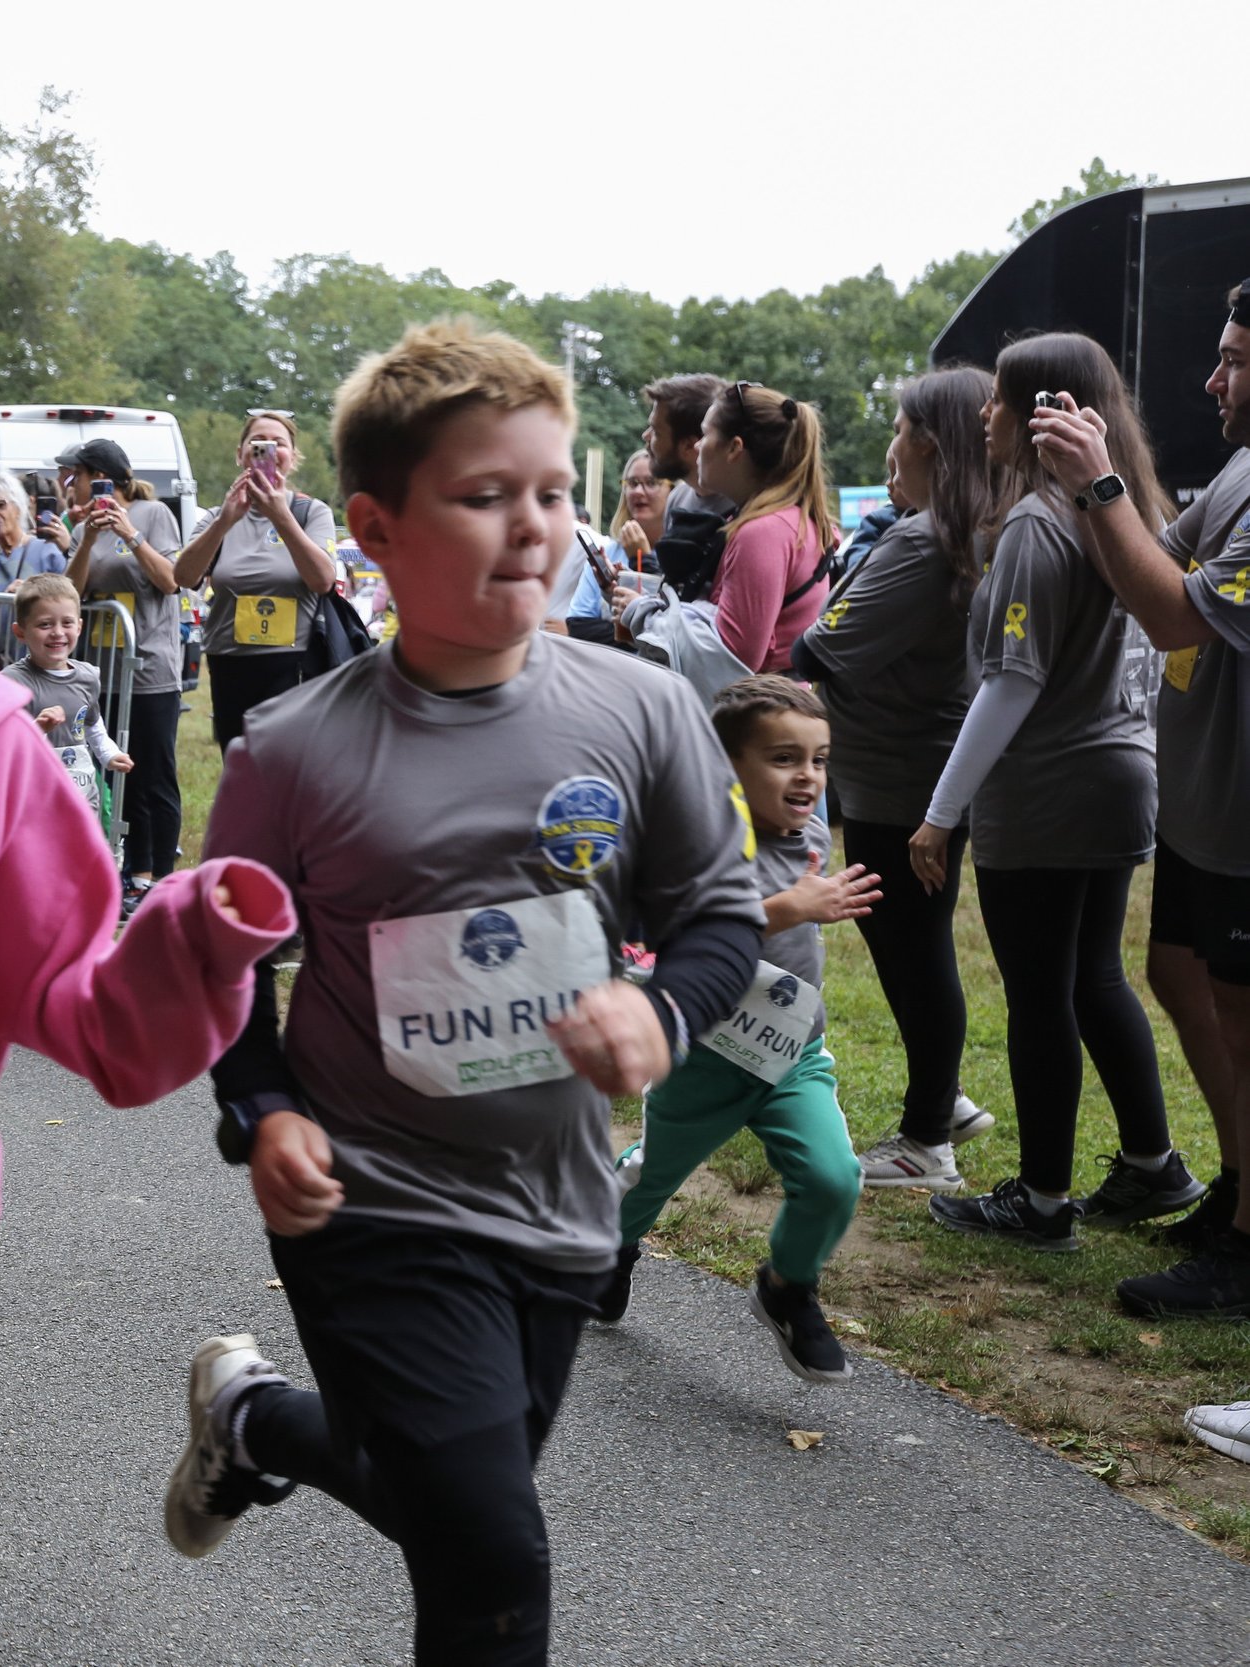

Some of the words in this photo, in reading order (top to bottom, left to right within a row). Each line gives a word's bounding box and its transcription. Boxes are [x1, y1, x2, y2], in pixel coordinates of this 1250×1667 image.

[261, 619, 268, 634] 9
[400, 1005, 493, 1049] FUN
[755, 1025, 802, 1061] RUN
